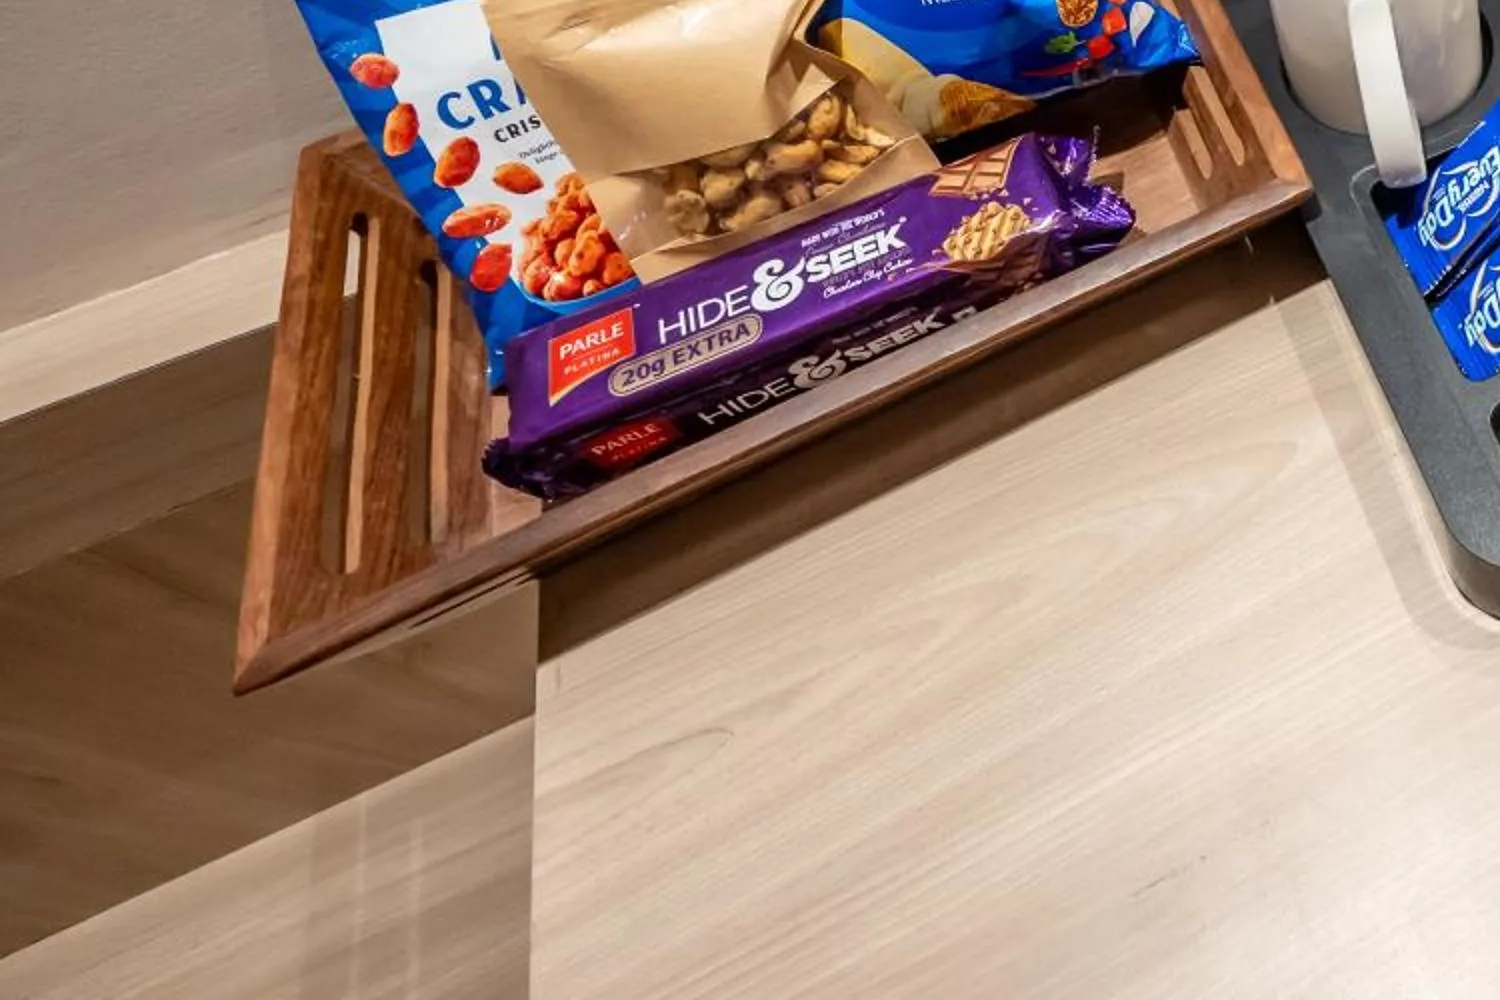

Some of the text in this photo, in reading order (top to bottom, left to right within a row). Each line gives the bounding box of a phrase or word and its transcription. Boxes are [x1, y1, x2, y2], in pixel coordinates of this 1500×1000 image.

[493, 114, 542, 143] CRIS
[657, 284, 751, 345] HIDE
[750, 256, 807, 313] &
[805, 222, 907, 283] SEEK
[559, 321, 624, 361] PARLE
[620, 322, 751, 388] 20g EXTRA
[563, 347, 621, 376] PLATINA
[699, 380, 797, 426] HIDE
[843, 311, 947, 362] SEEK
[590, 420, 661, 457] PARLE
